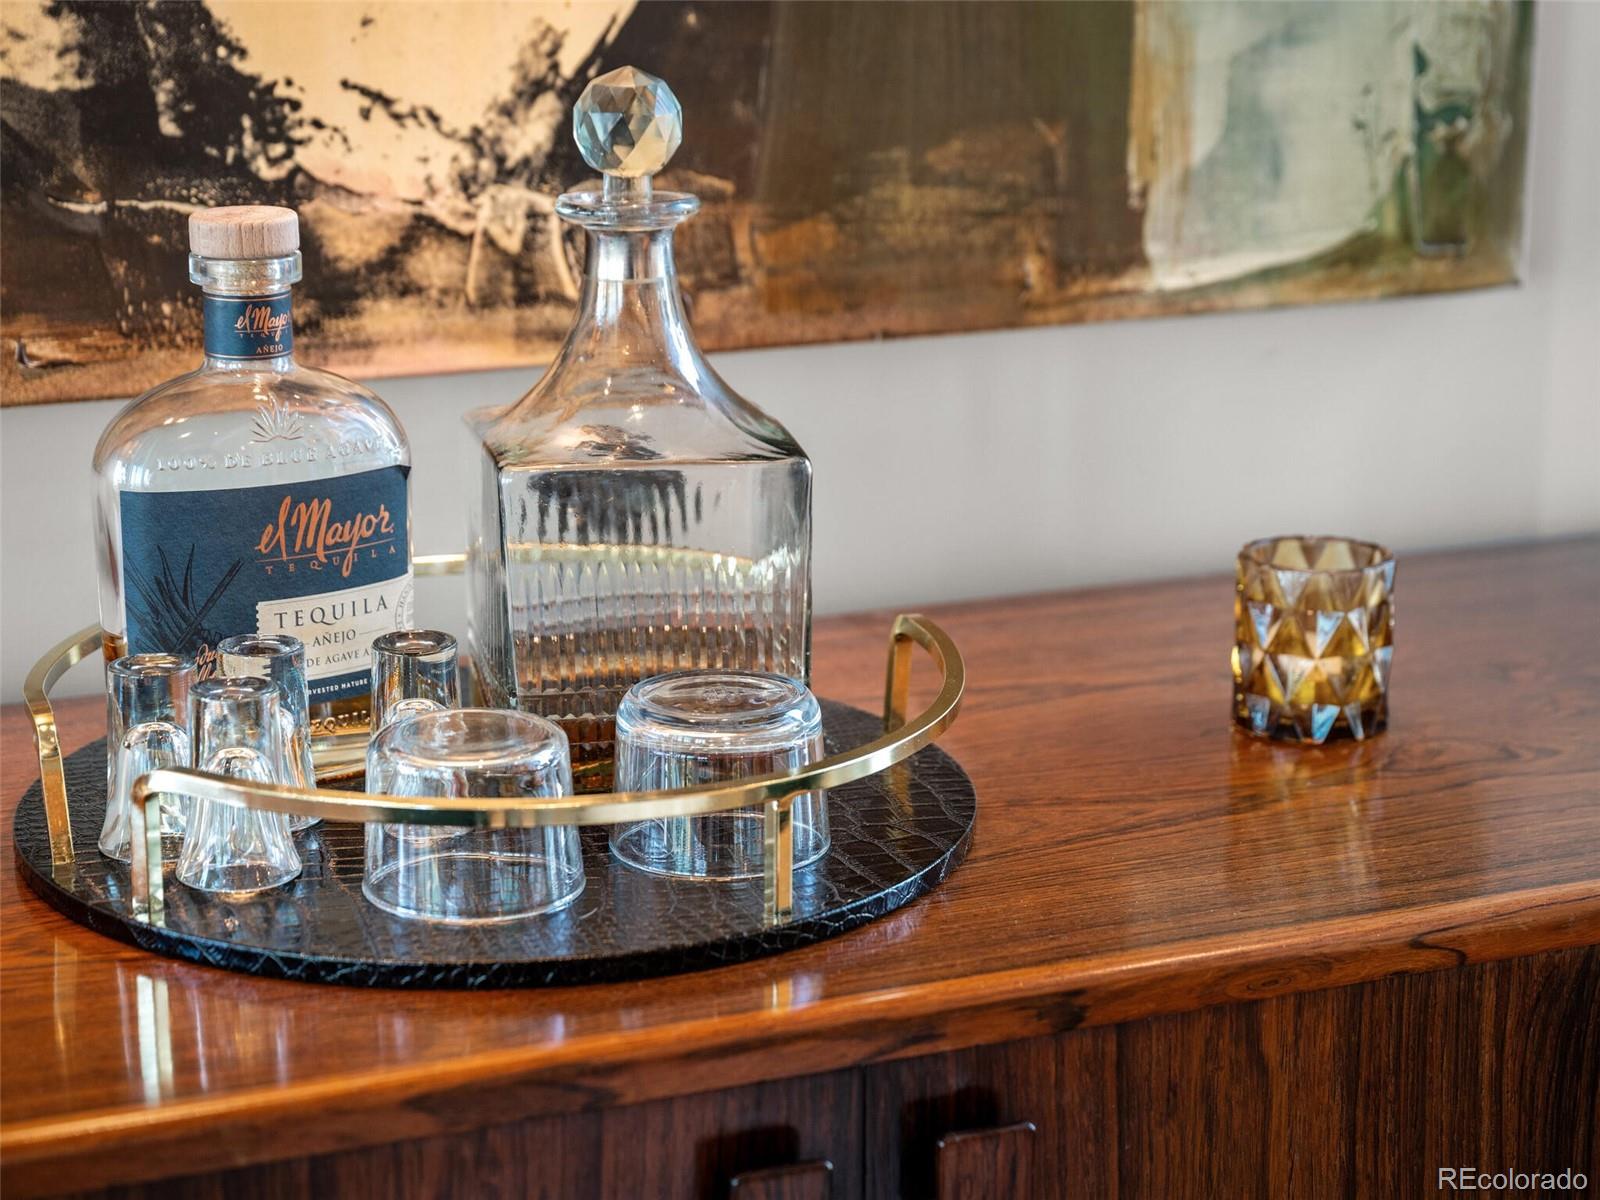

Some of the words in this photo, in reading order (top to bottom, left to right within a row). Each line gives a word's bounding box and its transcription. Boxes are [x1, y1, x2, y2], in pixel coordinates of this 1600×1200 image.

[234, 303, 252, 334] el
[256, 344, 284, 355] AÑEJO
[224, 452, 253, 469] DE
[261, 447, 317, 467] BLUE
[254, 495, 292, 562] el
[265, 545, 396, 576] TEQUILA
[273, 594, 388, 629] TEQUILA
[312, 629, 356, 648] AÑEJO
[306, 656, 321, 668] DE
[325, 648, 360, 665] AGAVE
[341, 678, 369, 690] NATURE
